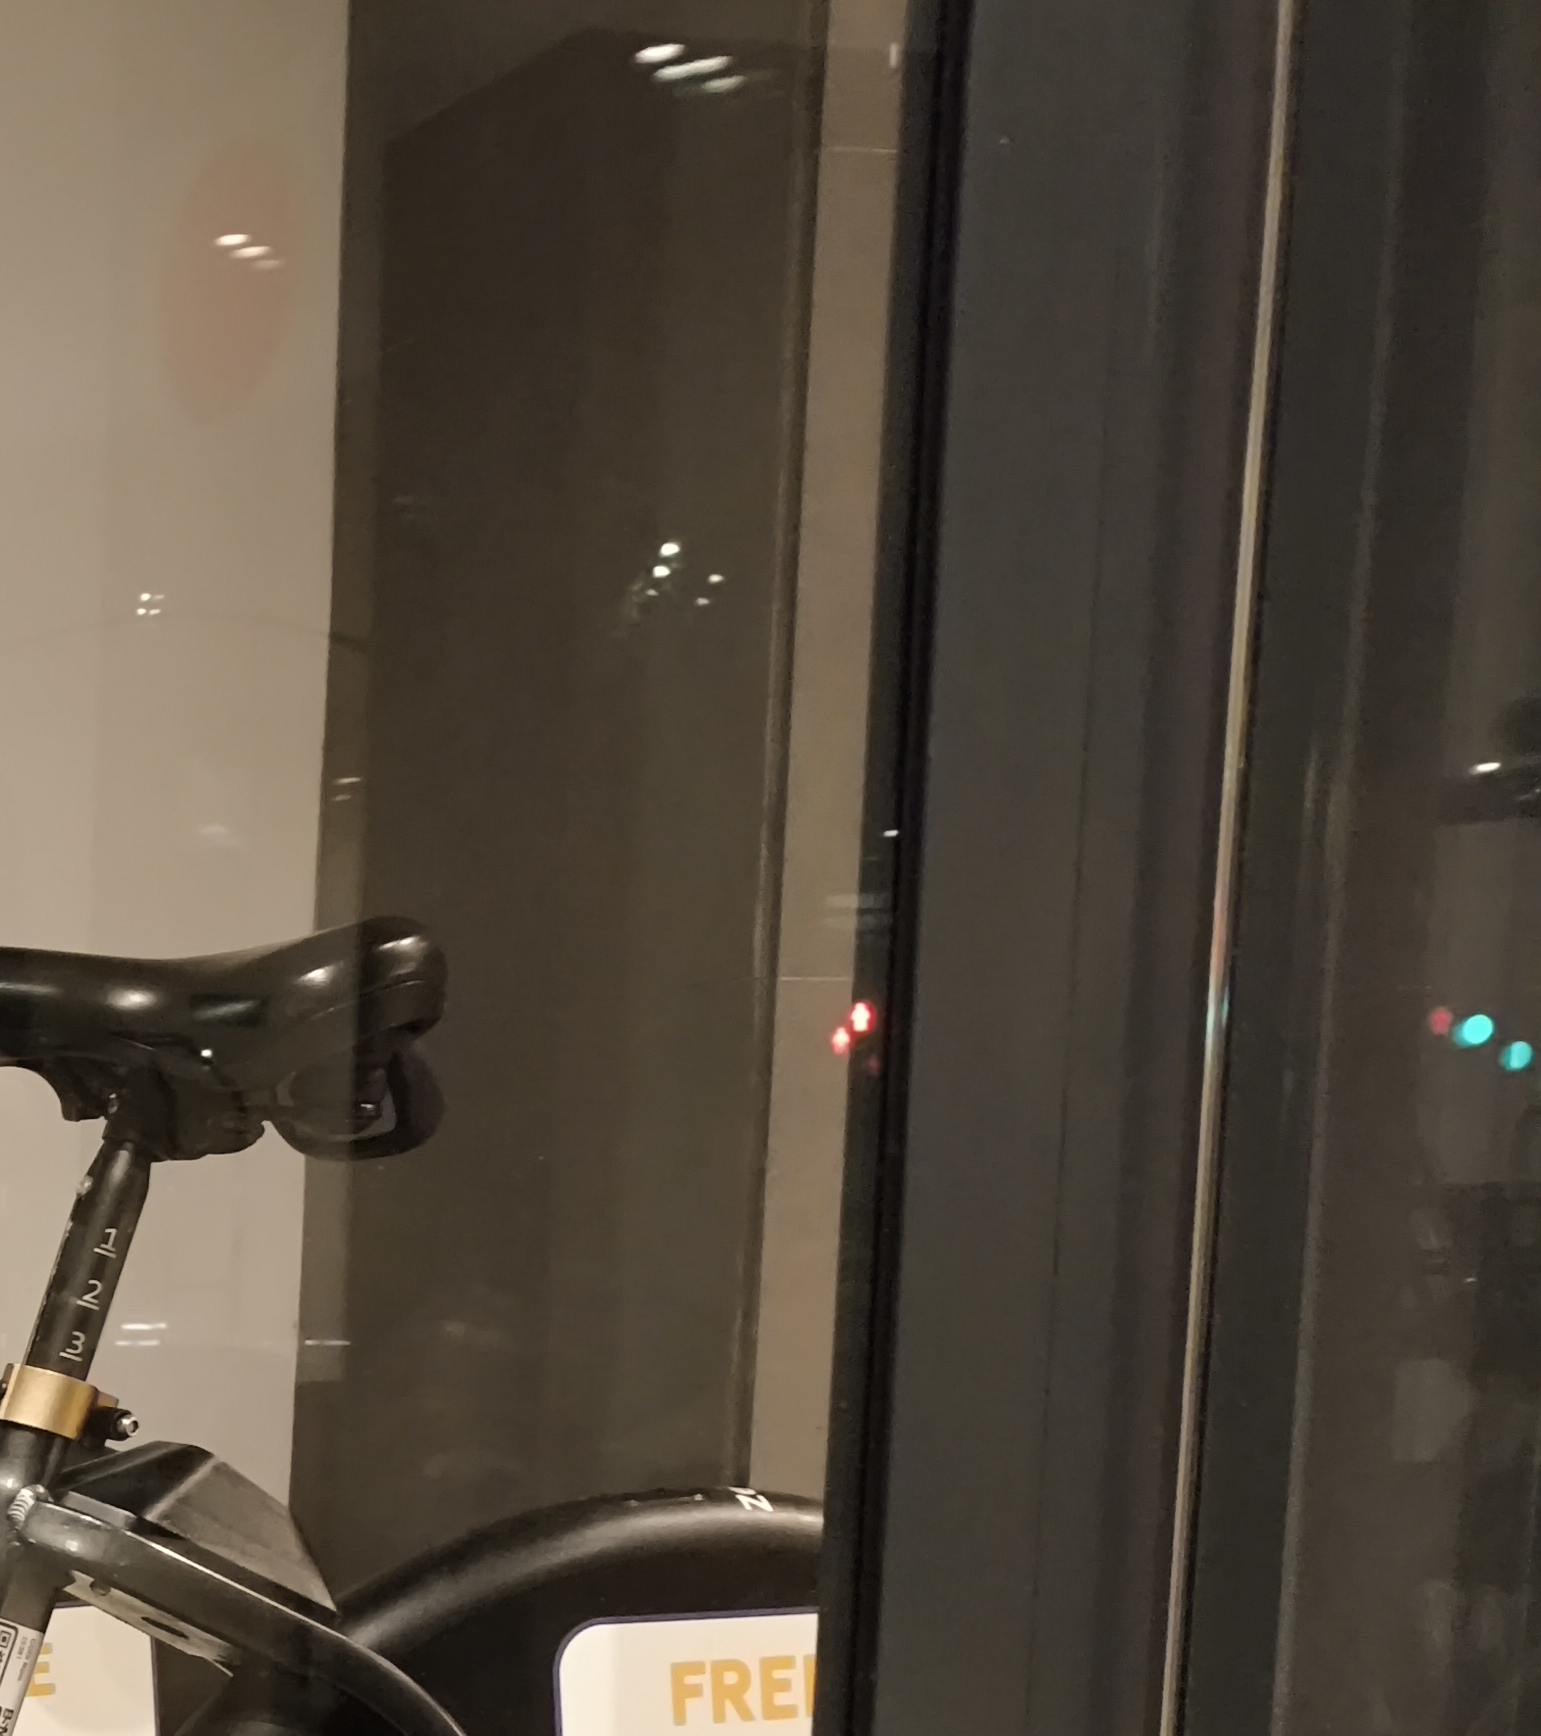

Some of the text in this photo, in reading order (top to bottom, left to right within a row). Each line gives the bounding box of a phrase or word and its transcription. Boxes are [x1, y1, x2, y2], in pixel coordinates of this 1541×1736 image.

[98, 1228, 117, 1253] 1
[80, 1279, 103, 1304] 2
[64, 1331, 86, 1355] 3
[671, 1653, 816, 1727] FRE
